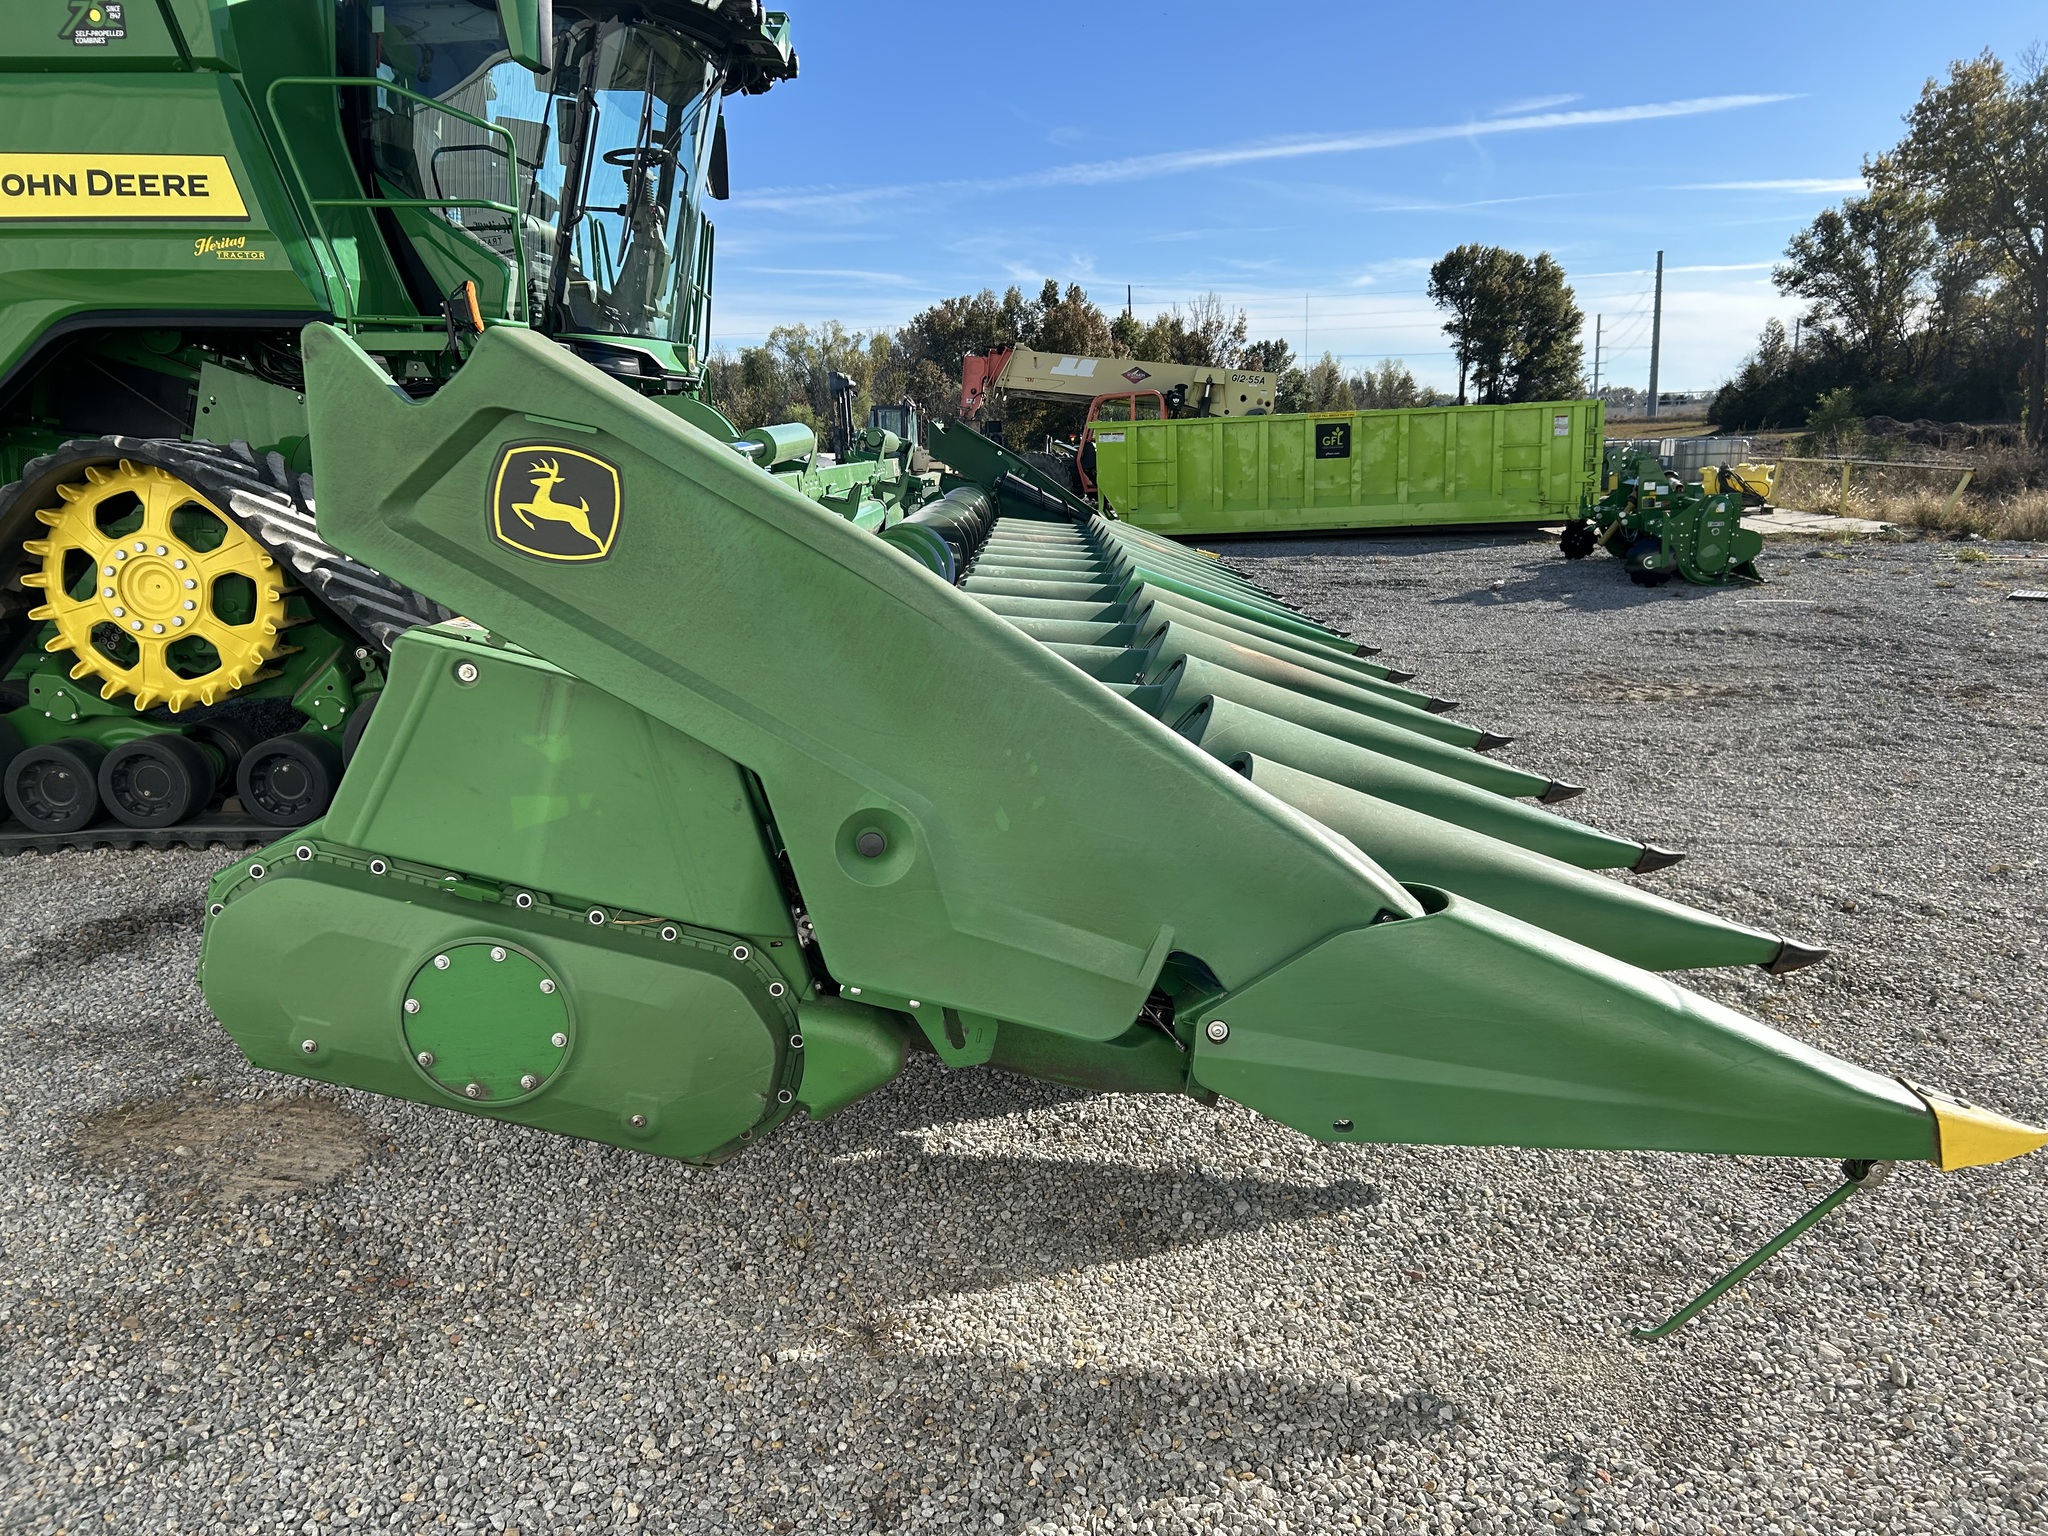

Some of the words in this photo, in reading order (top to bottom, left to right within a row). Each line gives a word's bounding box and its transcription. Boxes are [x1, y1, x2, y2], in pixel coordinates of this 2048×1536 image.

[105, 5, 121, 13] SINCE
[109, 12, 121, 20] 1947
[75, 29, 124, 37] SELF-PROPELLED
[86, 168, 210, 197] DEERE
[216, 251, 265, 259] TRACTOR
[1322, 431, 1344, 446] GFL
